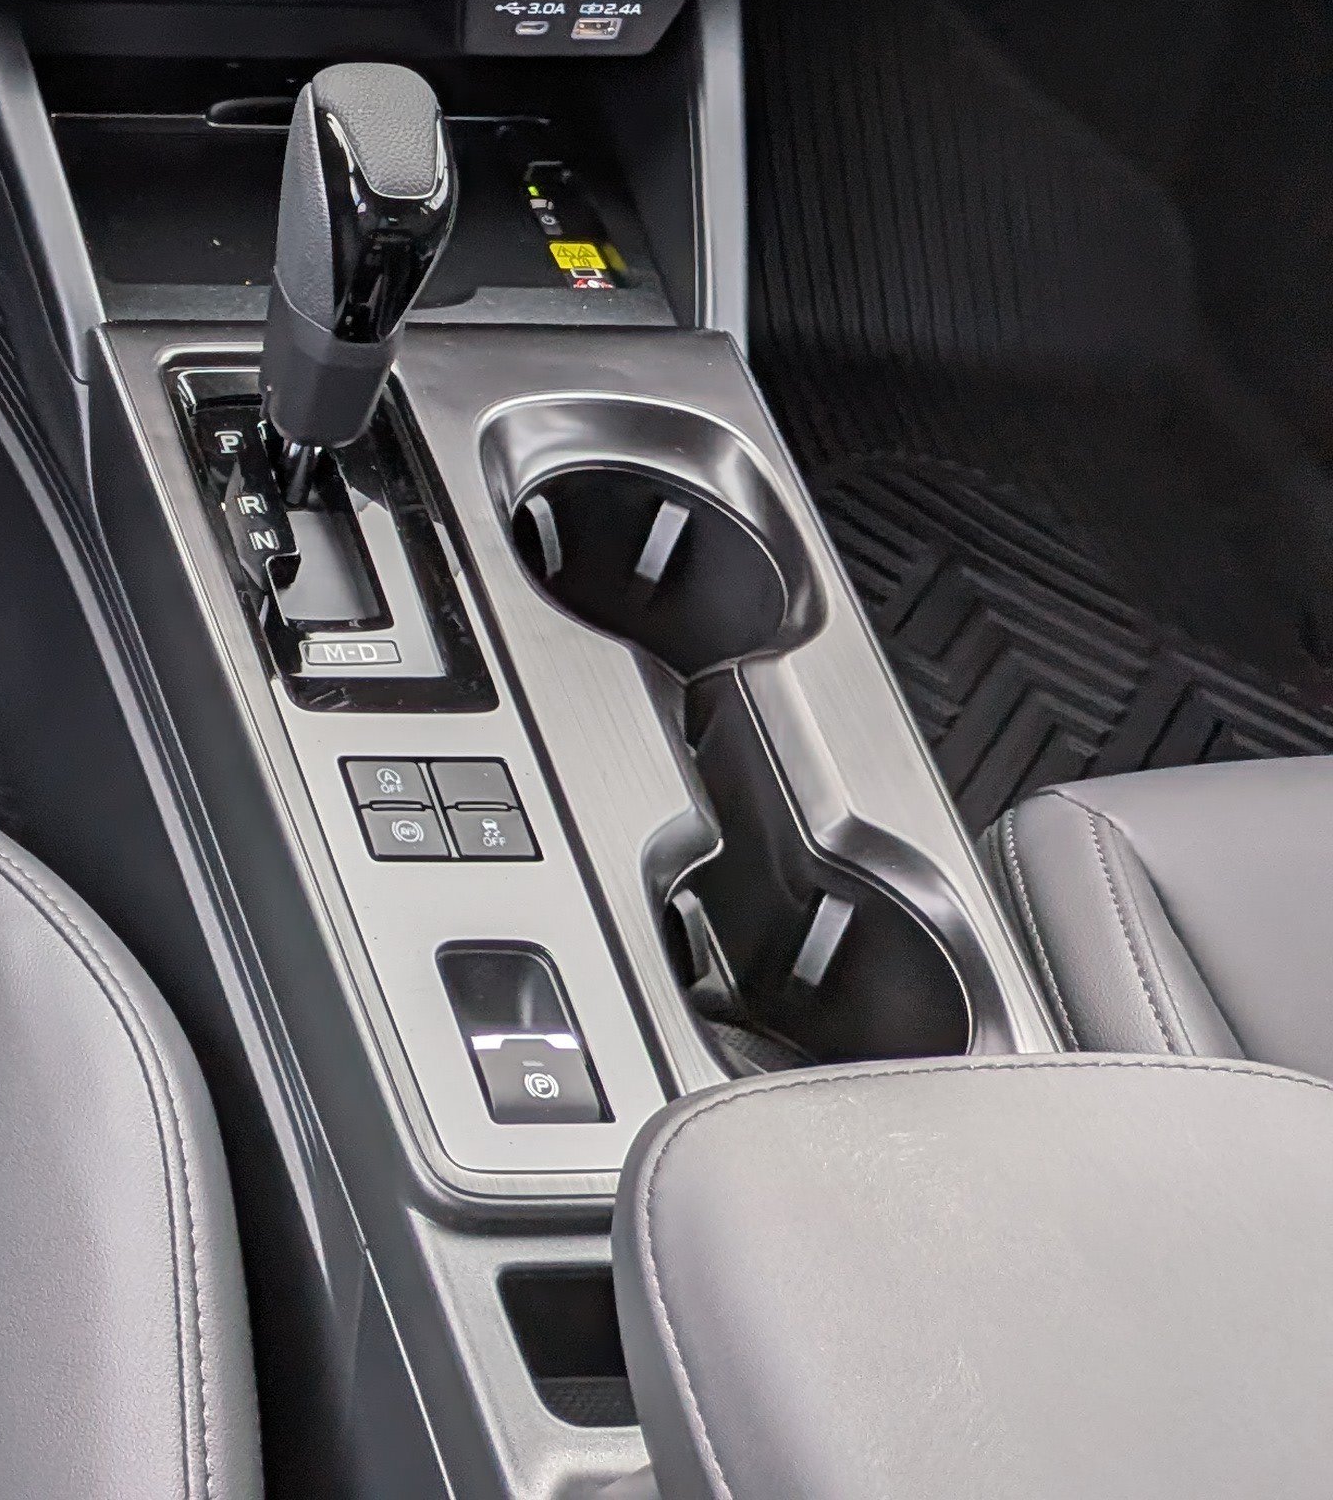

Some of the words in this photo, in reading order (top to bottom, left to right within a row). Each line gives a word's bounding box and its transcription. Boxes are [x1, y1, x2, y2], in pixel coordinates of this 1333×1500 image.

[527, 2, 565, 15] 3.0A
[604, 3, 642, 16] 2.4A
[241, 495, 265, 514] R
[253, 530, 274, 551] N
[380, 784, 403, 794] OFF
[482, 836, 506, 848] OFF
